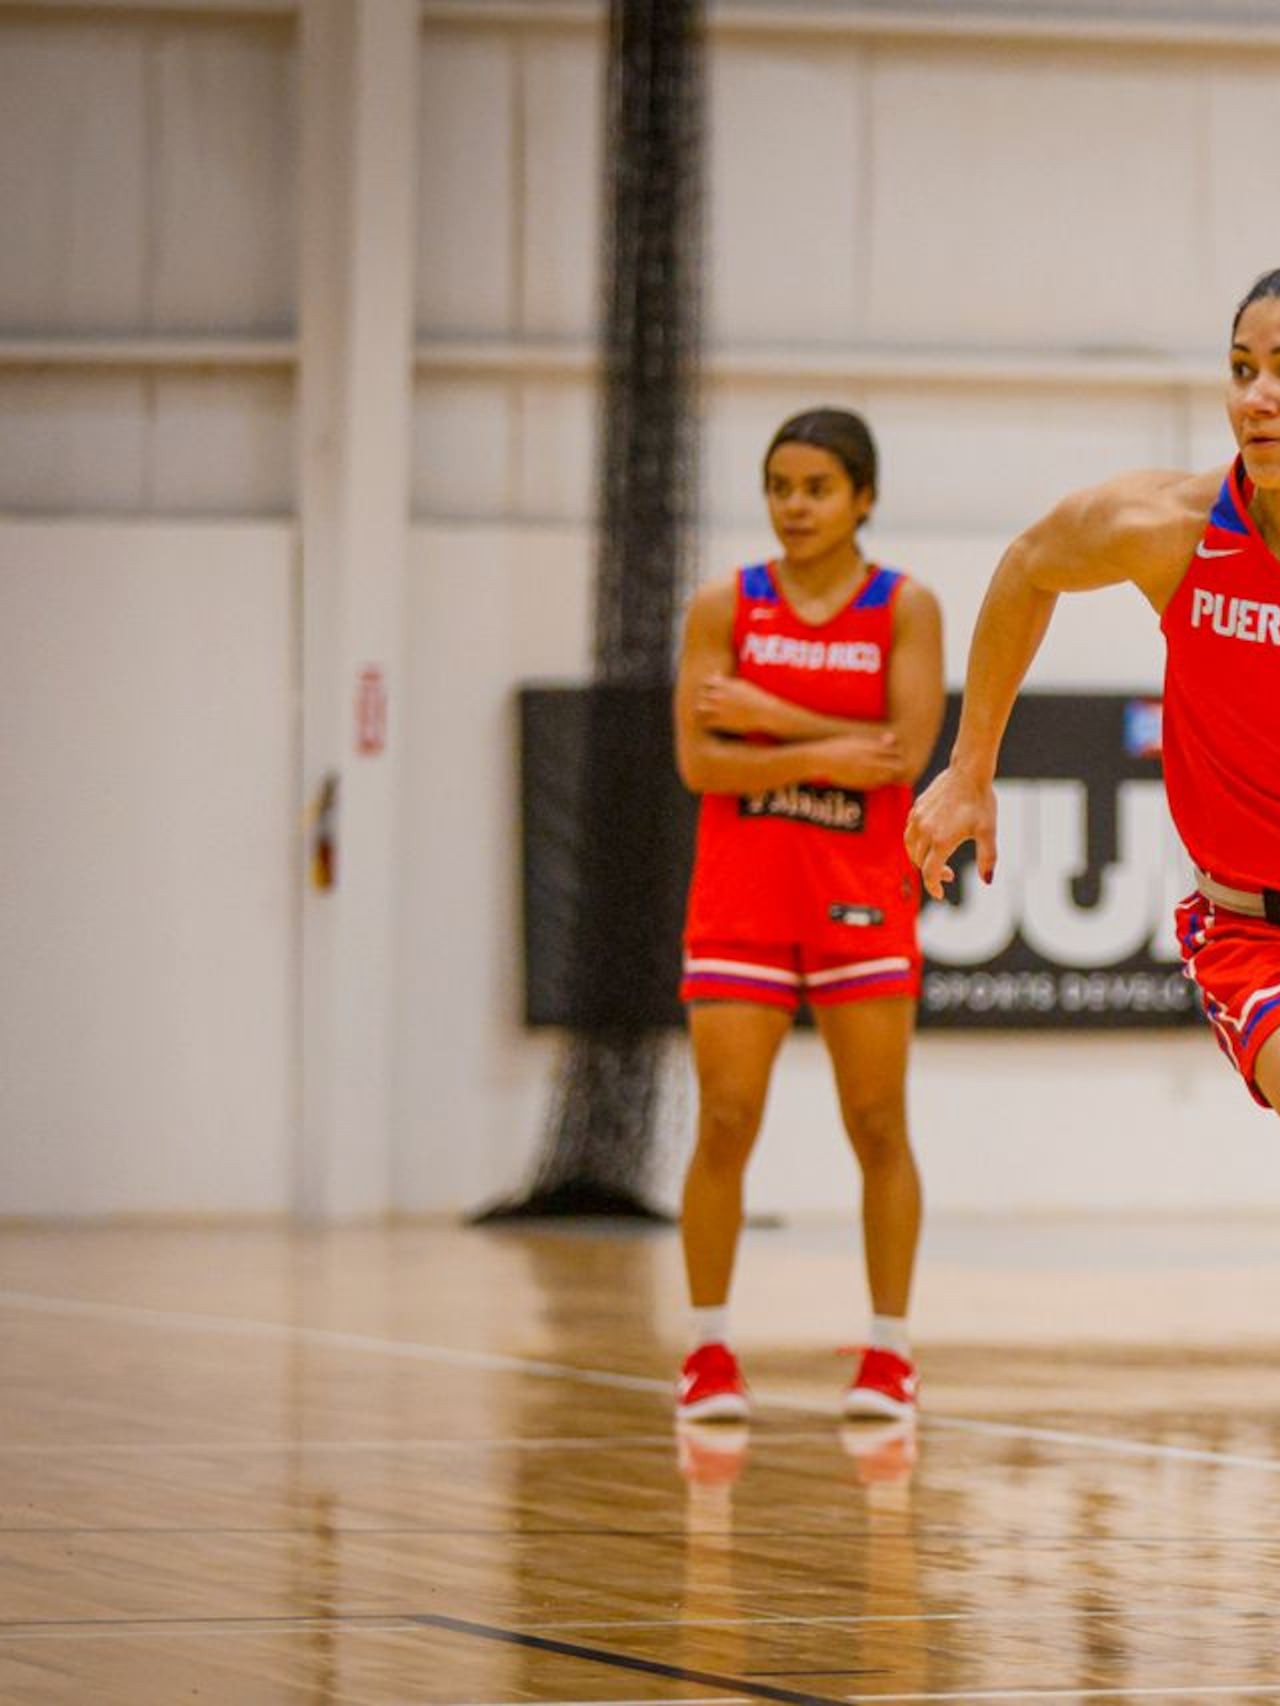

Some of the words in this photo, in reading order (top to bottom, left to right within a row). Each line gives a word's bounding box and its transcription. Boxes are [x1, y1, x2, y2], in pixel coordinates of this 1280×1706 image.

[741, 632, 825, 671] PUERTO
[827, 641, 881, 674] RICO
[925, 971, 1056, 1012] SPORTS
